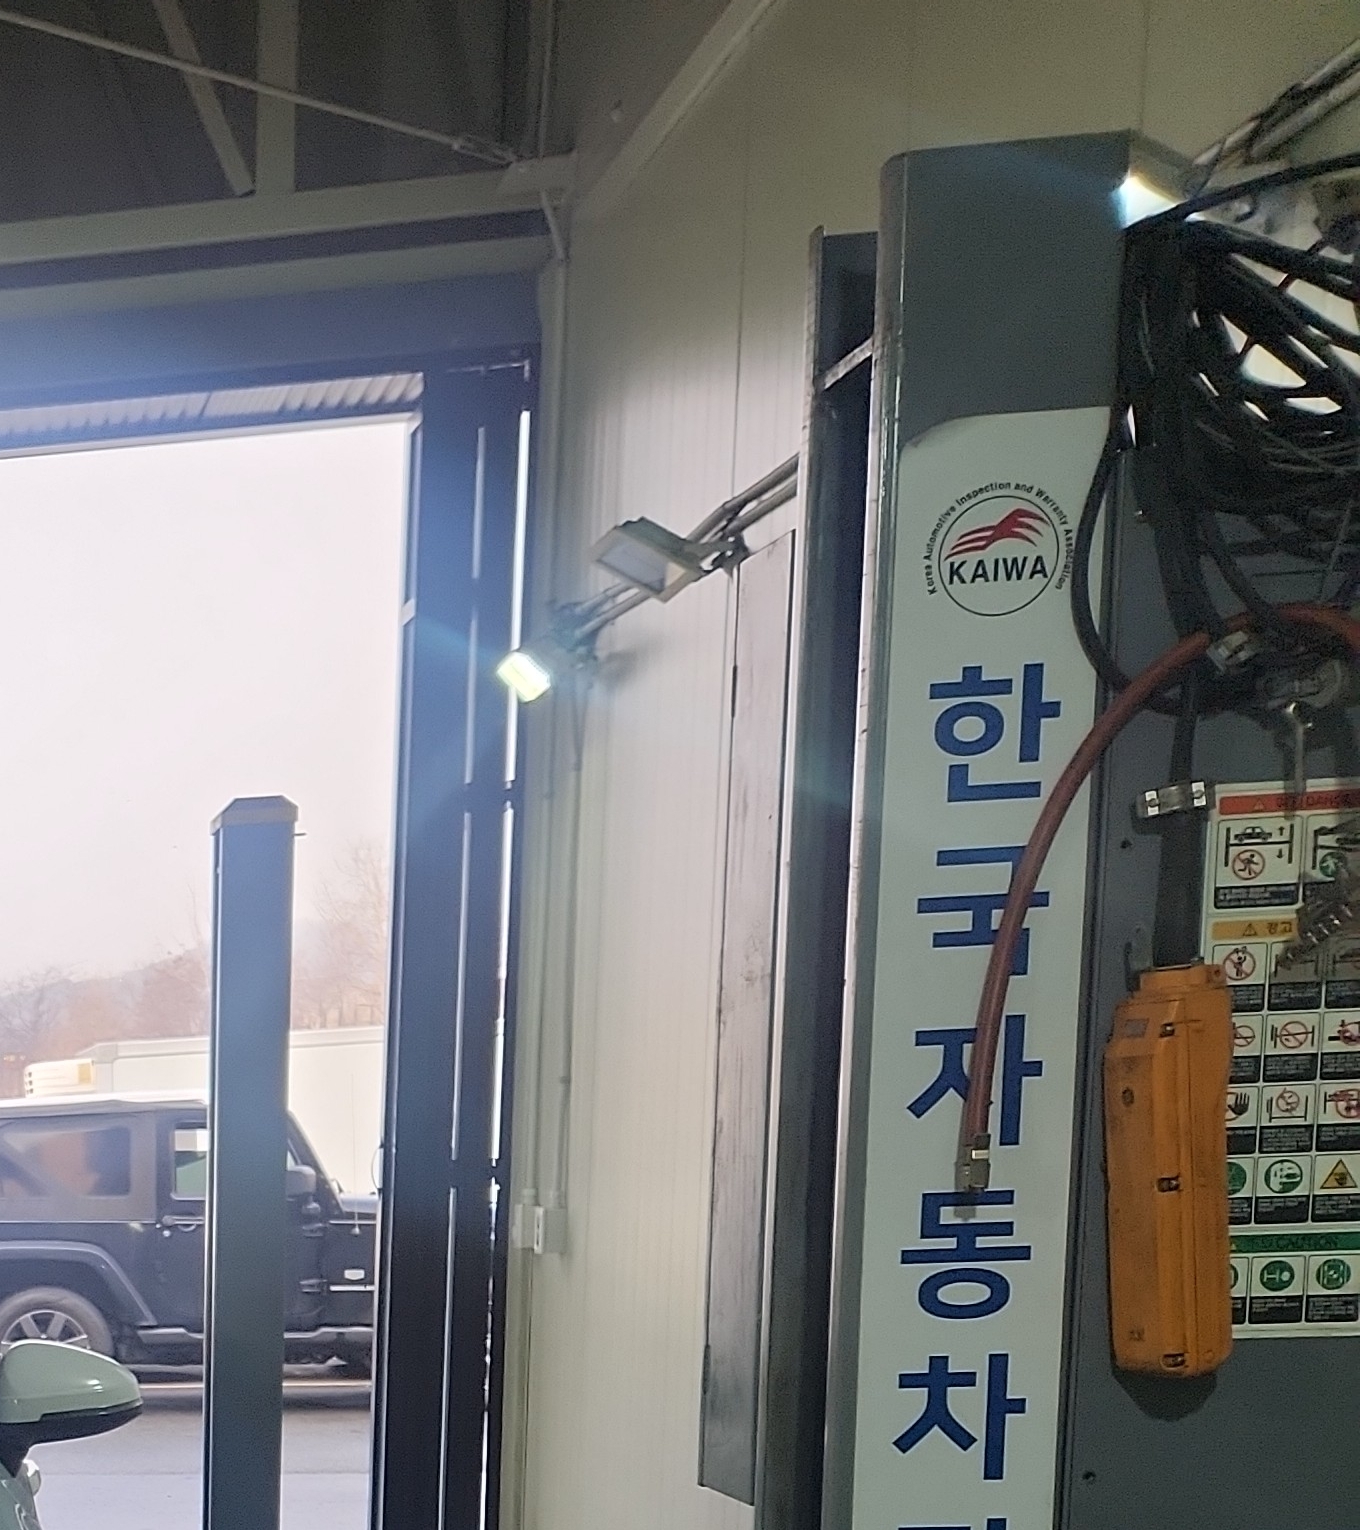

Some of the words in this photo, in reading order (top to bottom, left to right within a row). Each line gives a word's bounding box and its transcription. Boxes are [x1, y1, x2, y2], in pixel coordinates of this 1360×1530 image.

[956, 482, 1011, 507] Inspection
[1014, 482, 1034, 494] and
[1035, 488, 1069, 526] Warranty
[922, 506, 957, 561] Automotive
[924, 565, 937, 596] Korea
[948, 555, 1049, 586] KAIWA
